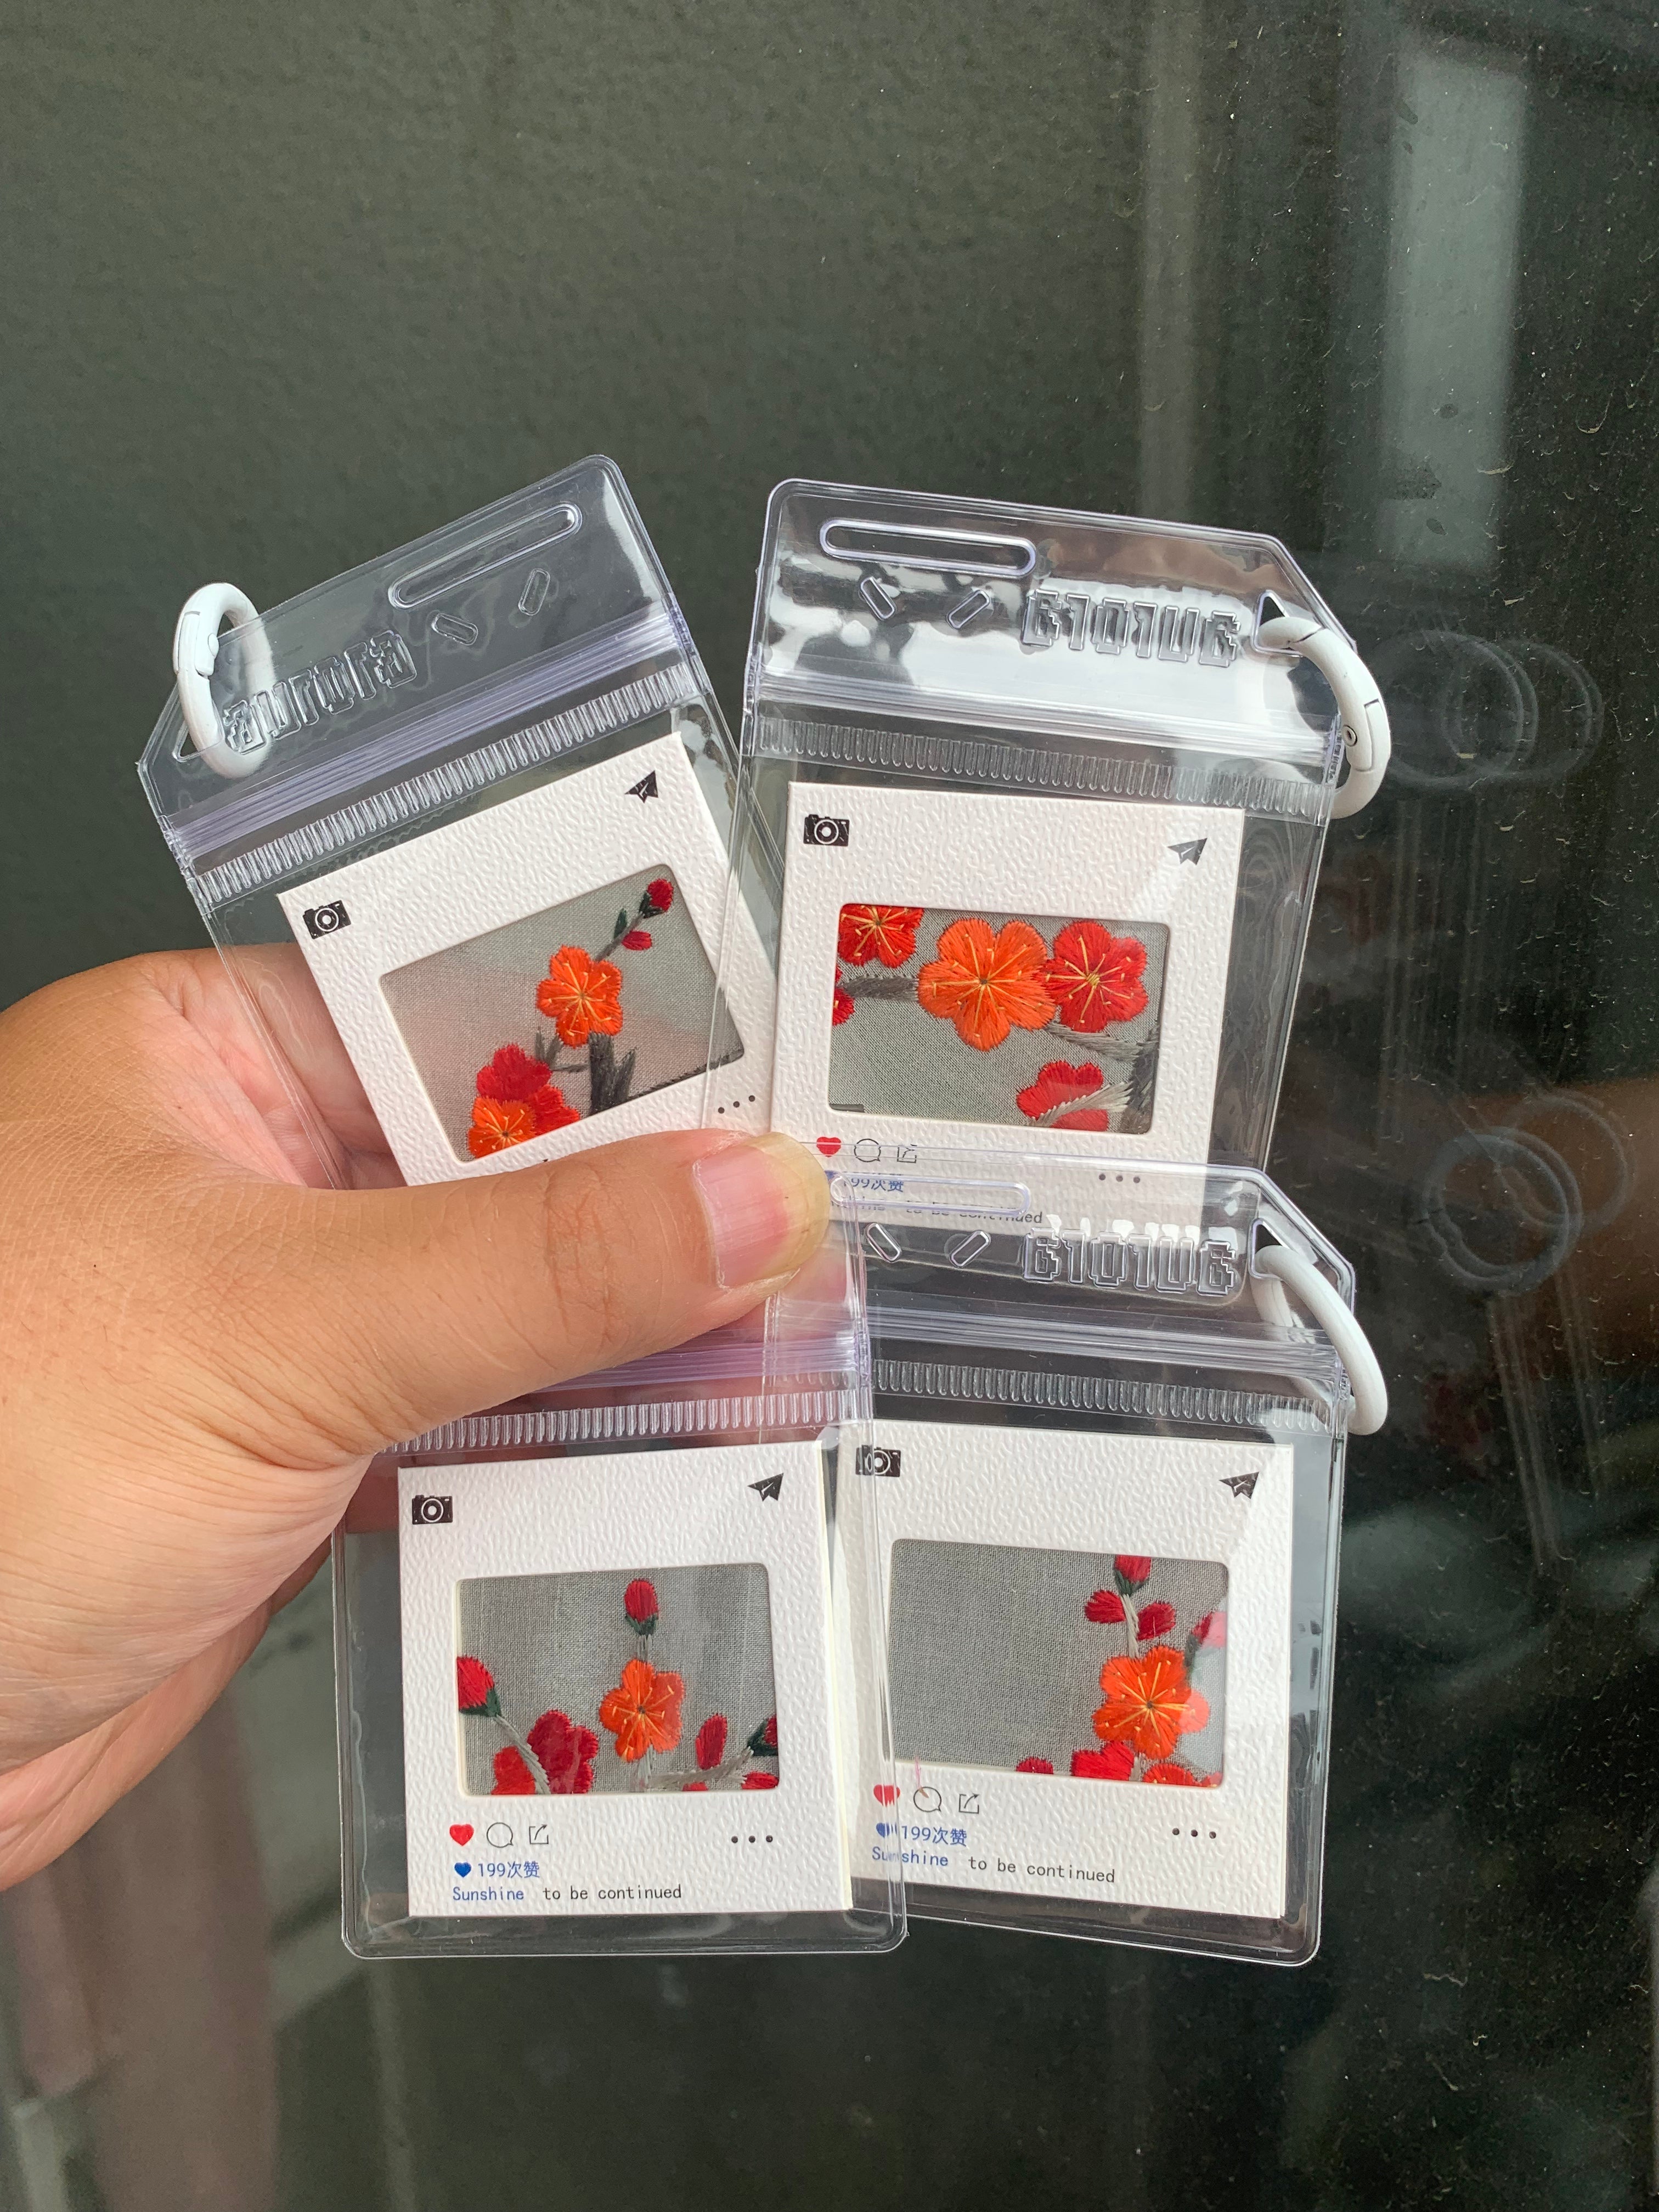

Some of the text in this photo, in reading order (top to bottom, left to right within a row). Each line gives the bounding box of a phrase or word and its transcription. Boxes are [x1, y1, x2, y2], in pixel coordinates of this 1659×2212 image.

[901, 1825, 967, 1847] 199次赞
[478, 1861, 540, 1878] 199次赞
[968, 1856, 987, 1870] to
[997, 1858, 1016, 1872] be
[1026, 1864, 1115, 1883] continued
[453, 1884, 681, 1901] Sunshine to be continued
